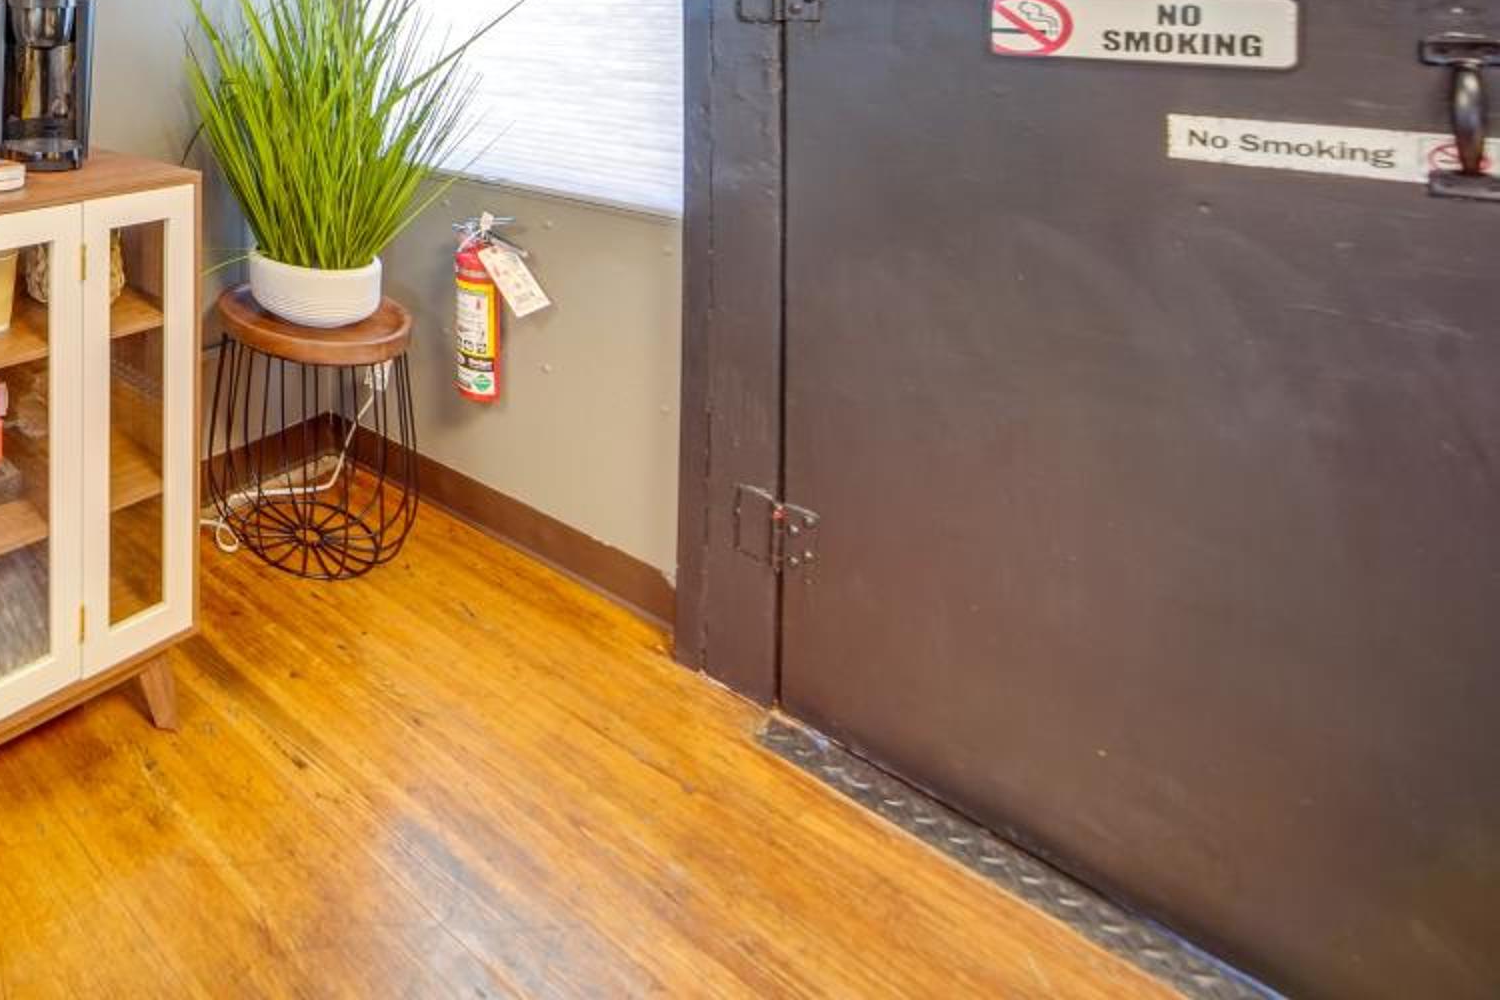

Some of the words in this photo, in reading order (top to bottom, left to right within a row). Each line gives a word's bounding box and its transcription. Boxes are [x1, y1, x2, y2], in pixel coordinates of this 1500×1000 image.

[1157, 3, 1201, 27] NO
[1102, 29, 1263, 58] SMOKING
[1186, 128, 1228, 150] No
[1238, 132, 1396, 169] Smoking
